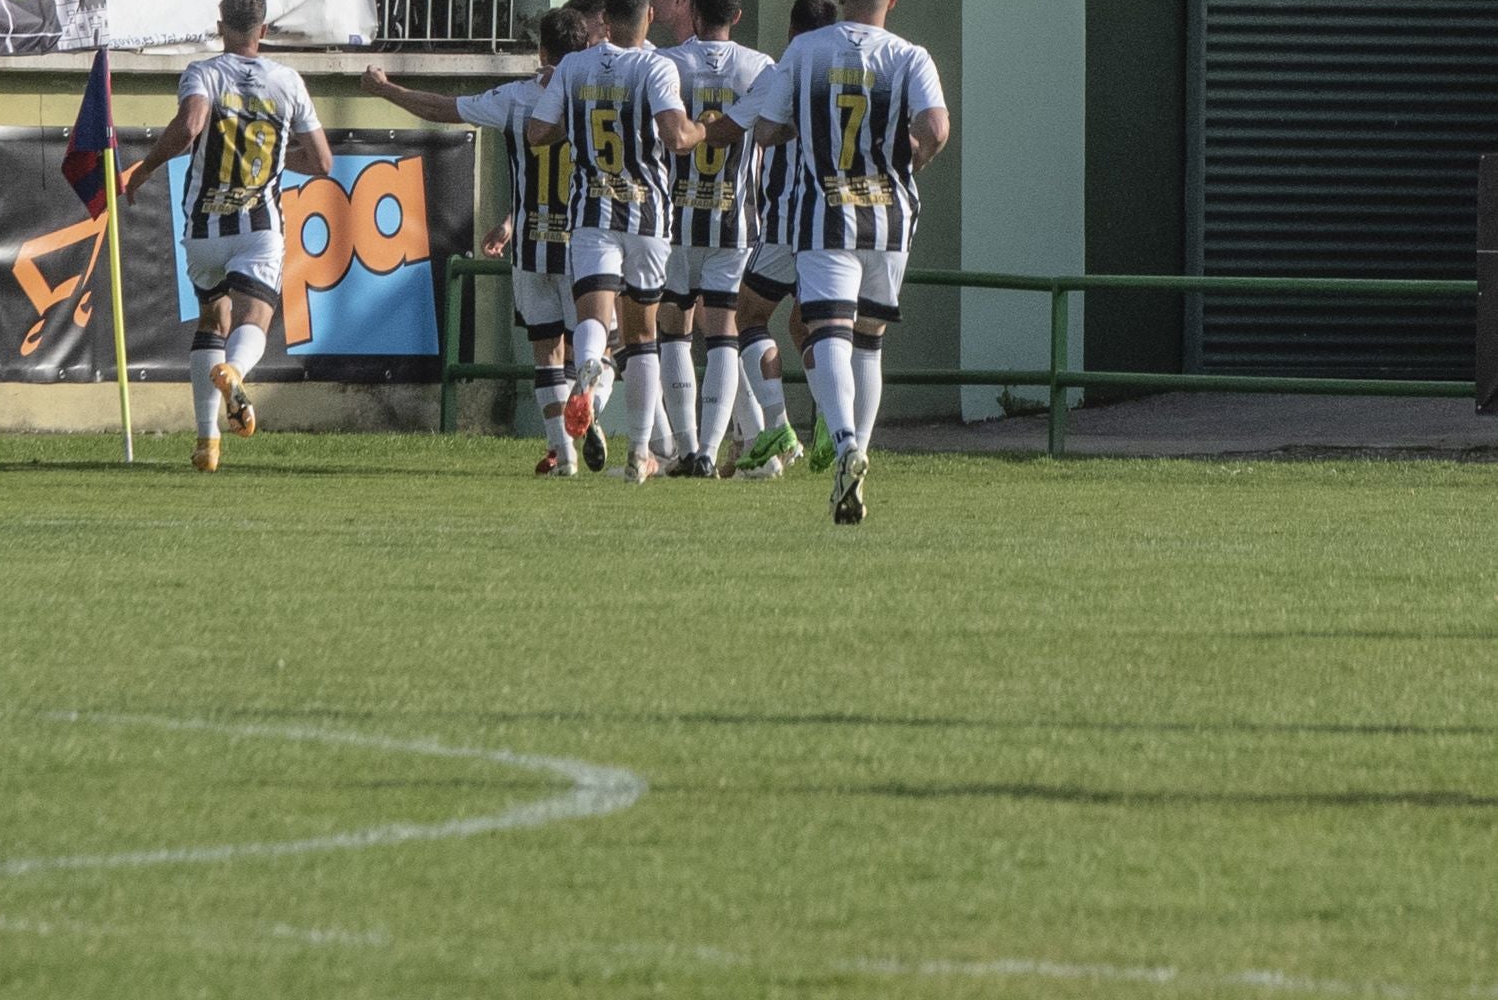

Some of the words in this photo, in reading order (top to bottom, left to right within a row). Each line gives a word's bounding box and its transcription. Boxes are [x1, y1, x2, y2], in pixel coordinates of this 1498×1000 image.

[217, 117, 276, 188] 18
[590, 108, 624, 176] 5
[836, 93, 868, 171] 7
[282, 155, 430, 347] pa
